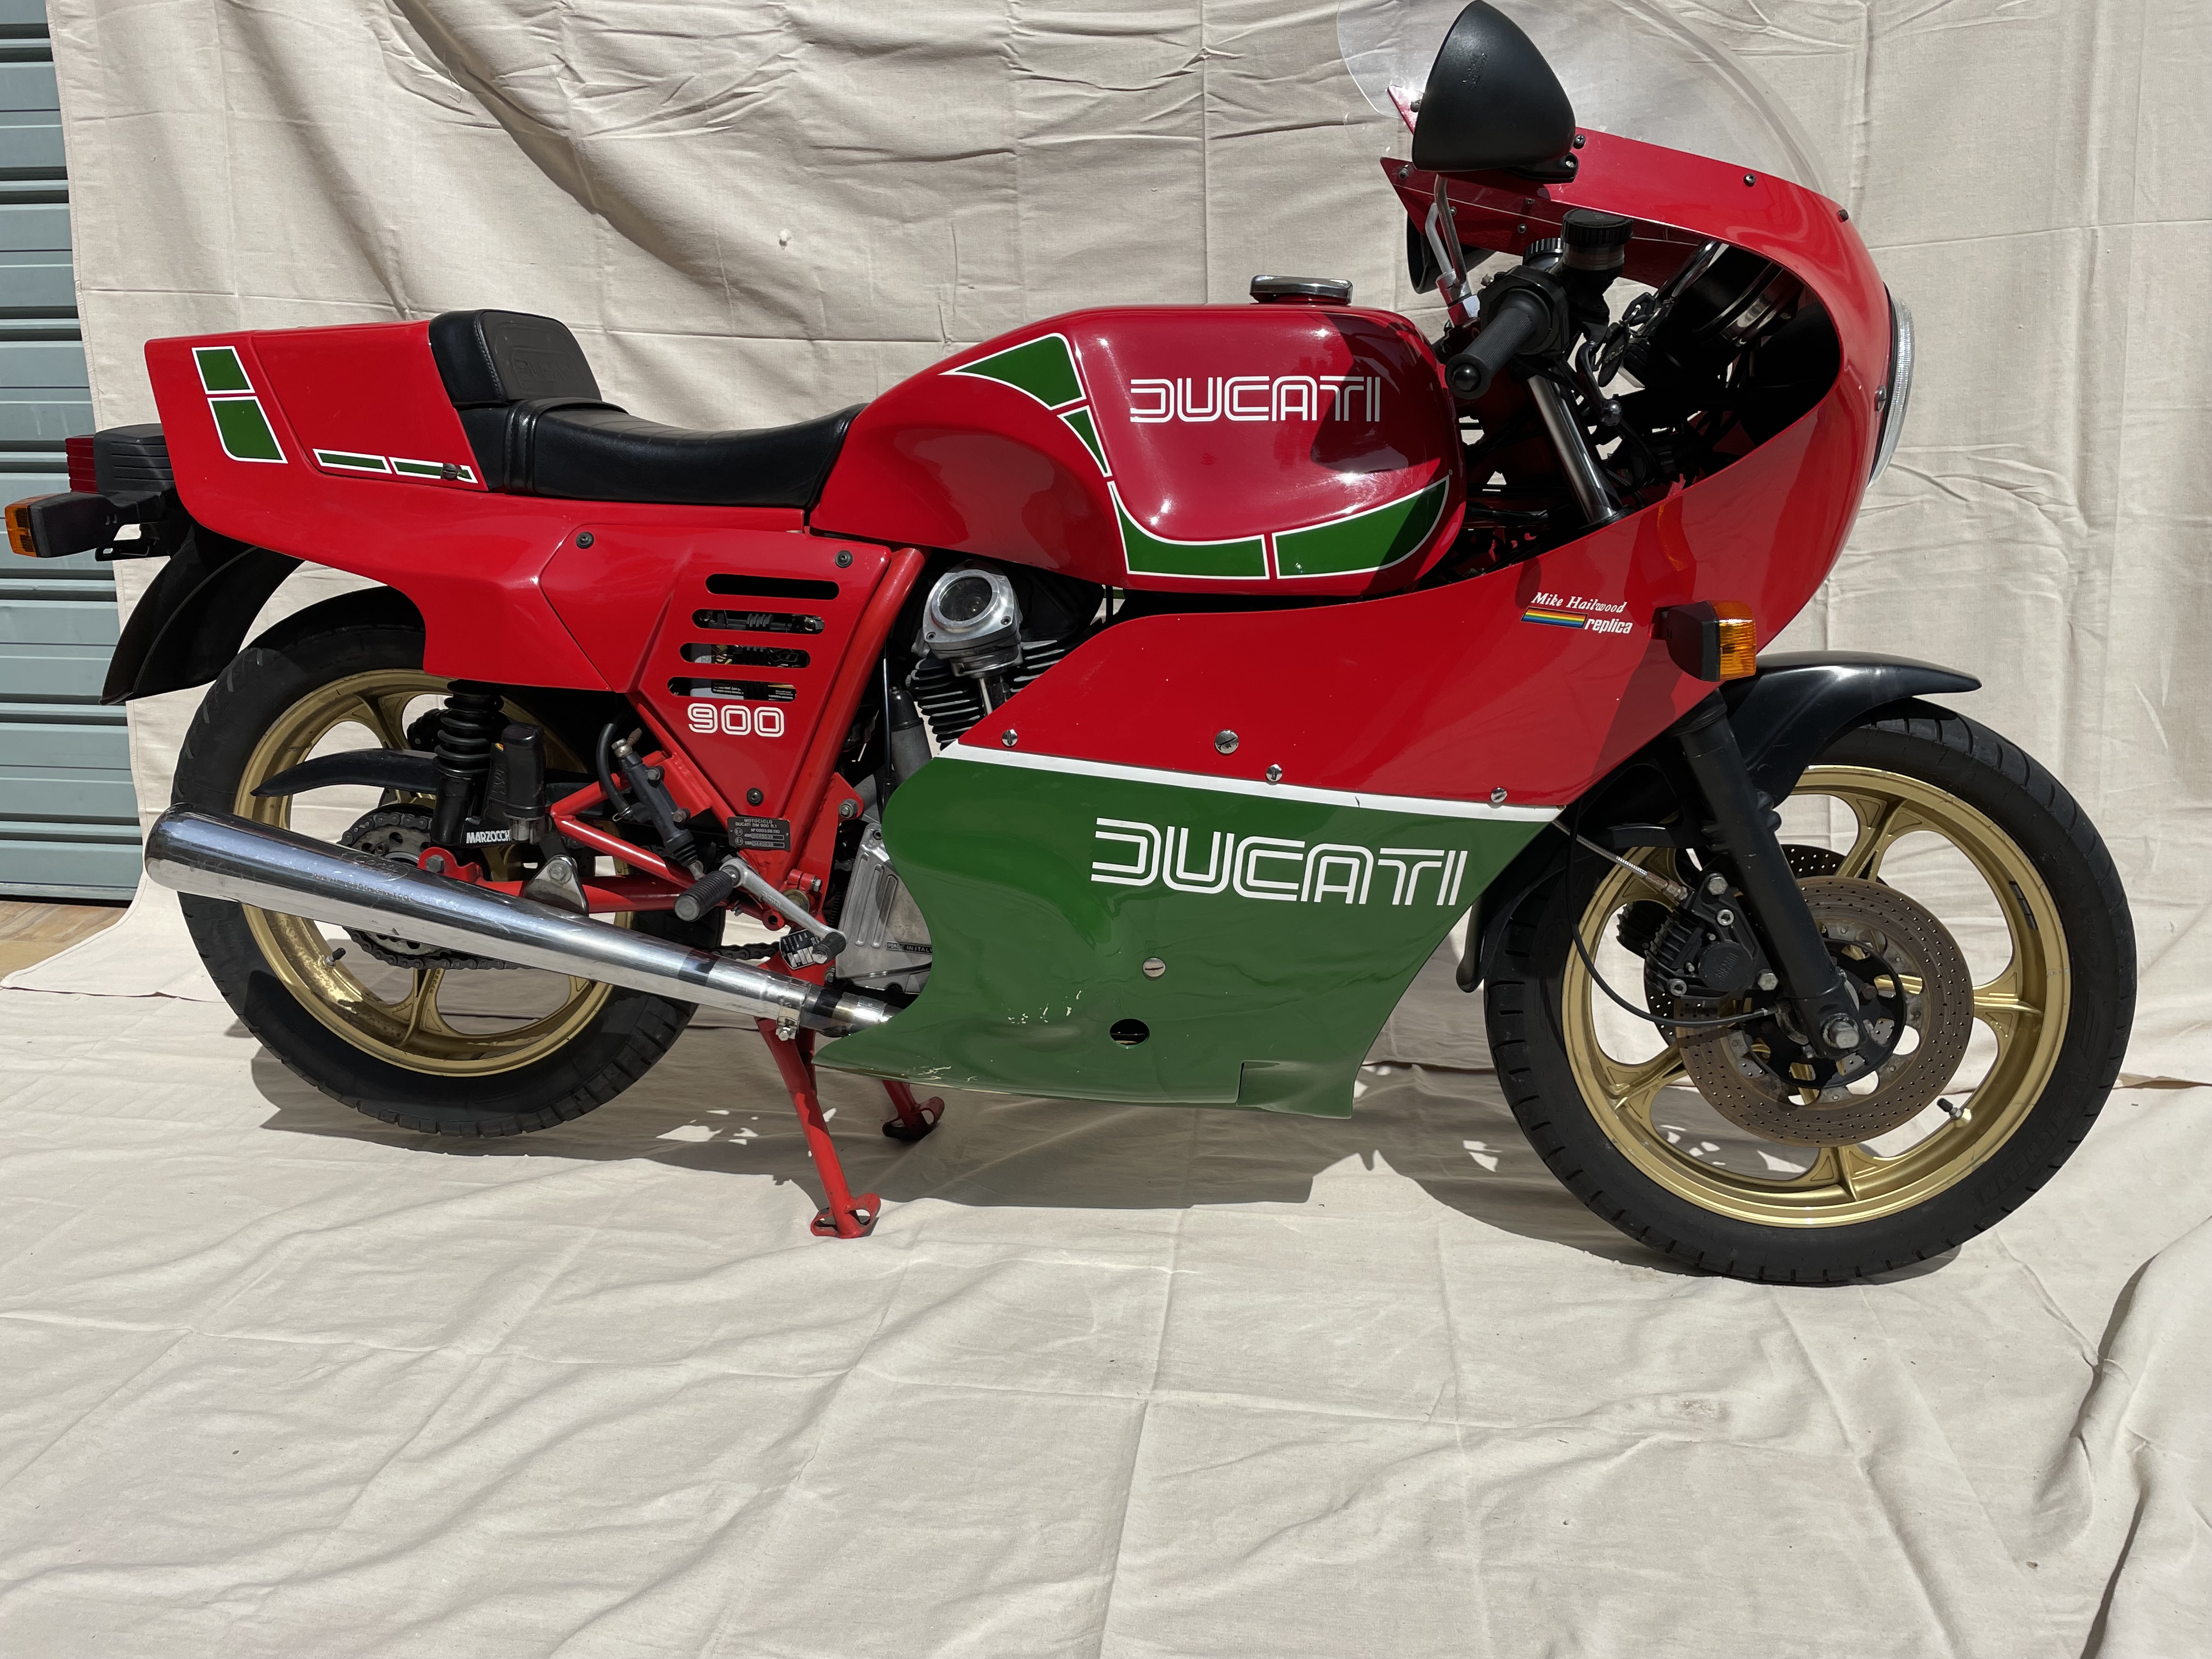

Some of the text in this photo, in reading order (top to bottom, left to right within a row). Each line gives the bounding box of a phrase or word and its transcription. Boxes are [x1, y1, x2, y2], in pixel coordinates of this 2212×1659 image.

[1130, 376, 1380, 422] DUCATI
[1531, 592, 1627, 613] Mike Hailwood
[1584, 618, 1633, 634] replica
[687, 703, 785, 737] 900
[466, 830, 511, 843] MARZOCCH
[1091, 817, 1468, 906] DUCATI
